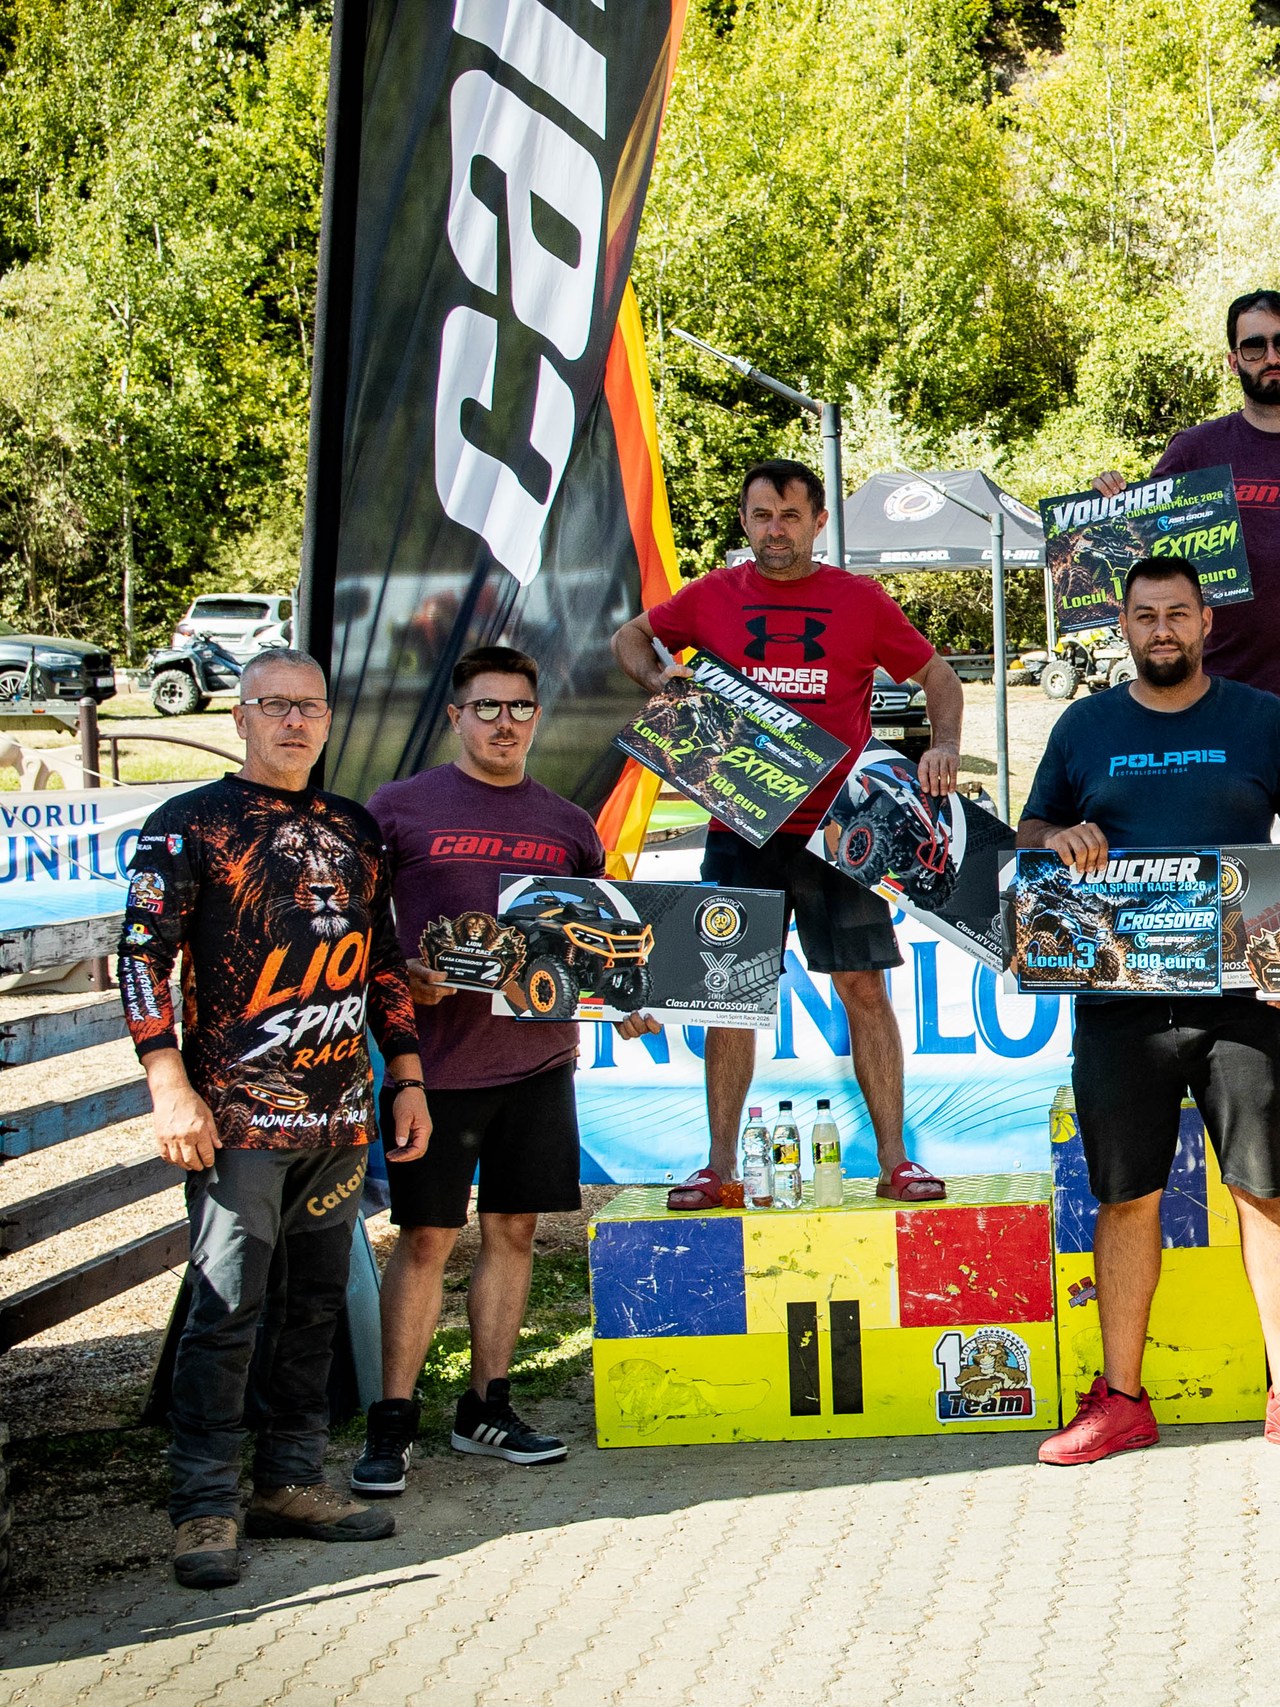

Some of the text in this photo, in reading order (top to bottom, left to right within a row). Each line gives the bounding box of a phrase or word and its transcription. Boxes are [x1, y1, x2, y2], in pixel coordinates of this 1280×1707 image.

[1052, 477, 1175, 533] VOUCHER
[1201, 490, 1224, 502] 2026
[1152, 520, 1238, 558] EXTREM
[1198, 567, 1238, 585] euro
[1062, 576, 1124, 610] Locul 1
[741, 666, 829, 684] UNDER
[694, 661, 803, 734] VOUCHER
[756, 682, 826, 695] RMOUR
[632, 718, 672, 752] Locul
[669, 738, 696, 763] 2
[888, 728, 903, 737] LEU
[803, 746, 824, 765] 2026
[1109, 749, 1227, 777] POLARIS
[719, 745, 810, 803] EXTREM
[1116, 769, 1167, 777] ESTABLISHED
[706, 773, 736, 796] 700
[733, 791, 768, 821] euro
[429, 835, 567, 865] can-am
[1070, 857, 1200, 885] VOUCHER
[1082, 881, 1206, 893] LION SPIRIT RACE 2026
[1116, 911, 1216, 930] CROSSOVER
[956, 920, 976, 936] Clasa
[974, 934, 990, 945] ATV
[453, 945, 475, 953] SPIRIT
[1027, 942, 1095, 969] Locul 3
[480, 961, 502, 981] 2
[1125, 953, 1206, 969] 300 euro
[713, 975, 721, 985] 2
[666, 999, 759, 1012] Clasa ATV CROSSOVER
[293, 1033, 364, 1070] RACE
[250, 1112, 328, 1128] MONEASA
[960, 1338, 1026, 1372] LION RACING
[948, 1393, 1024, 1416] Team
